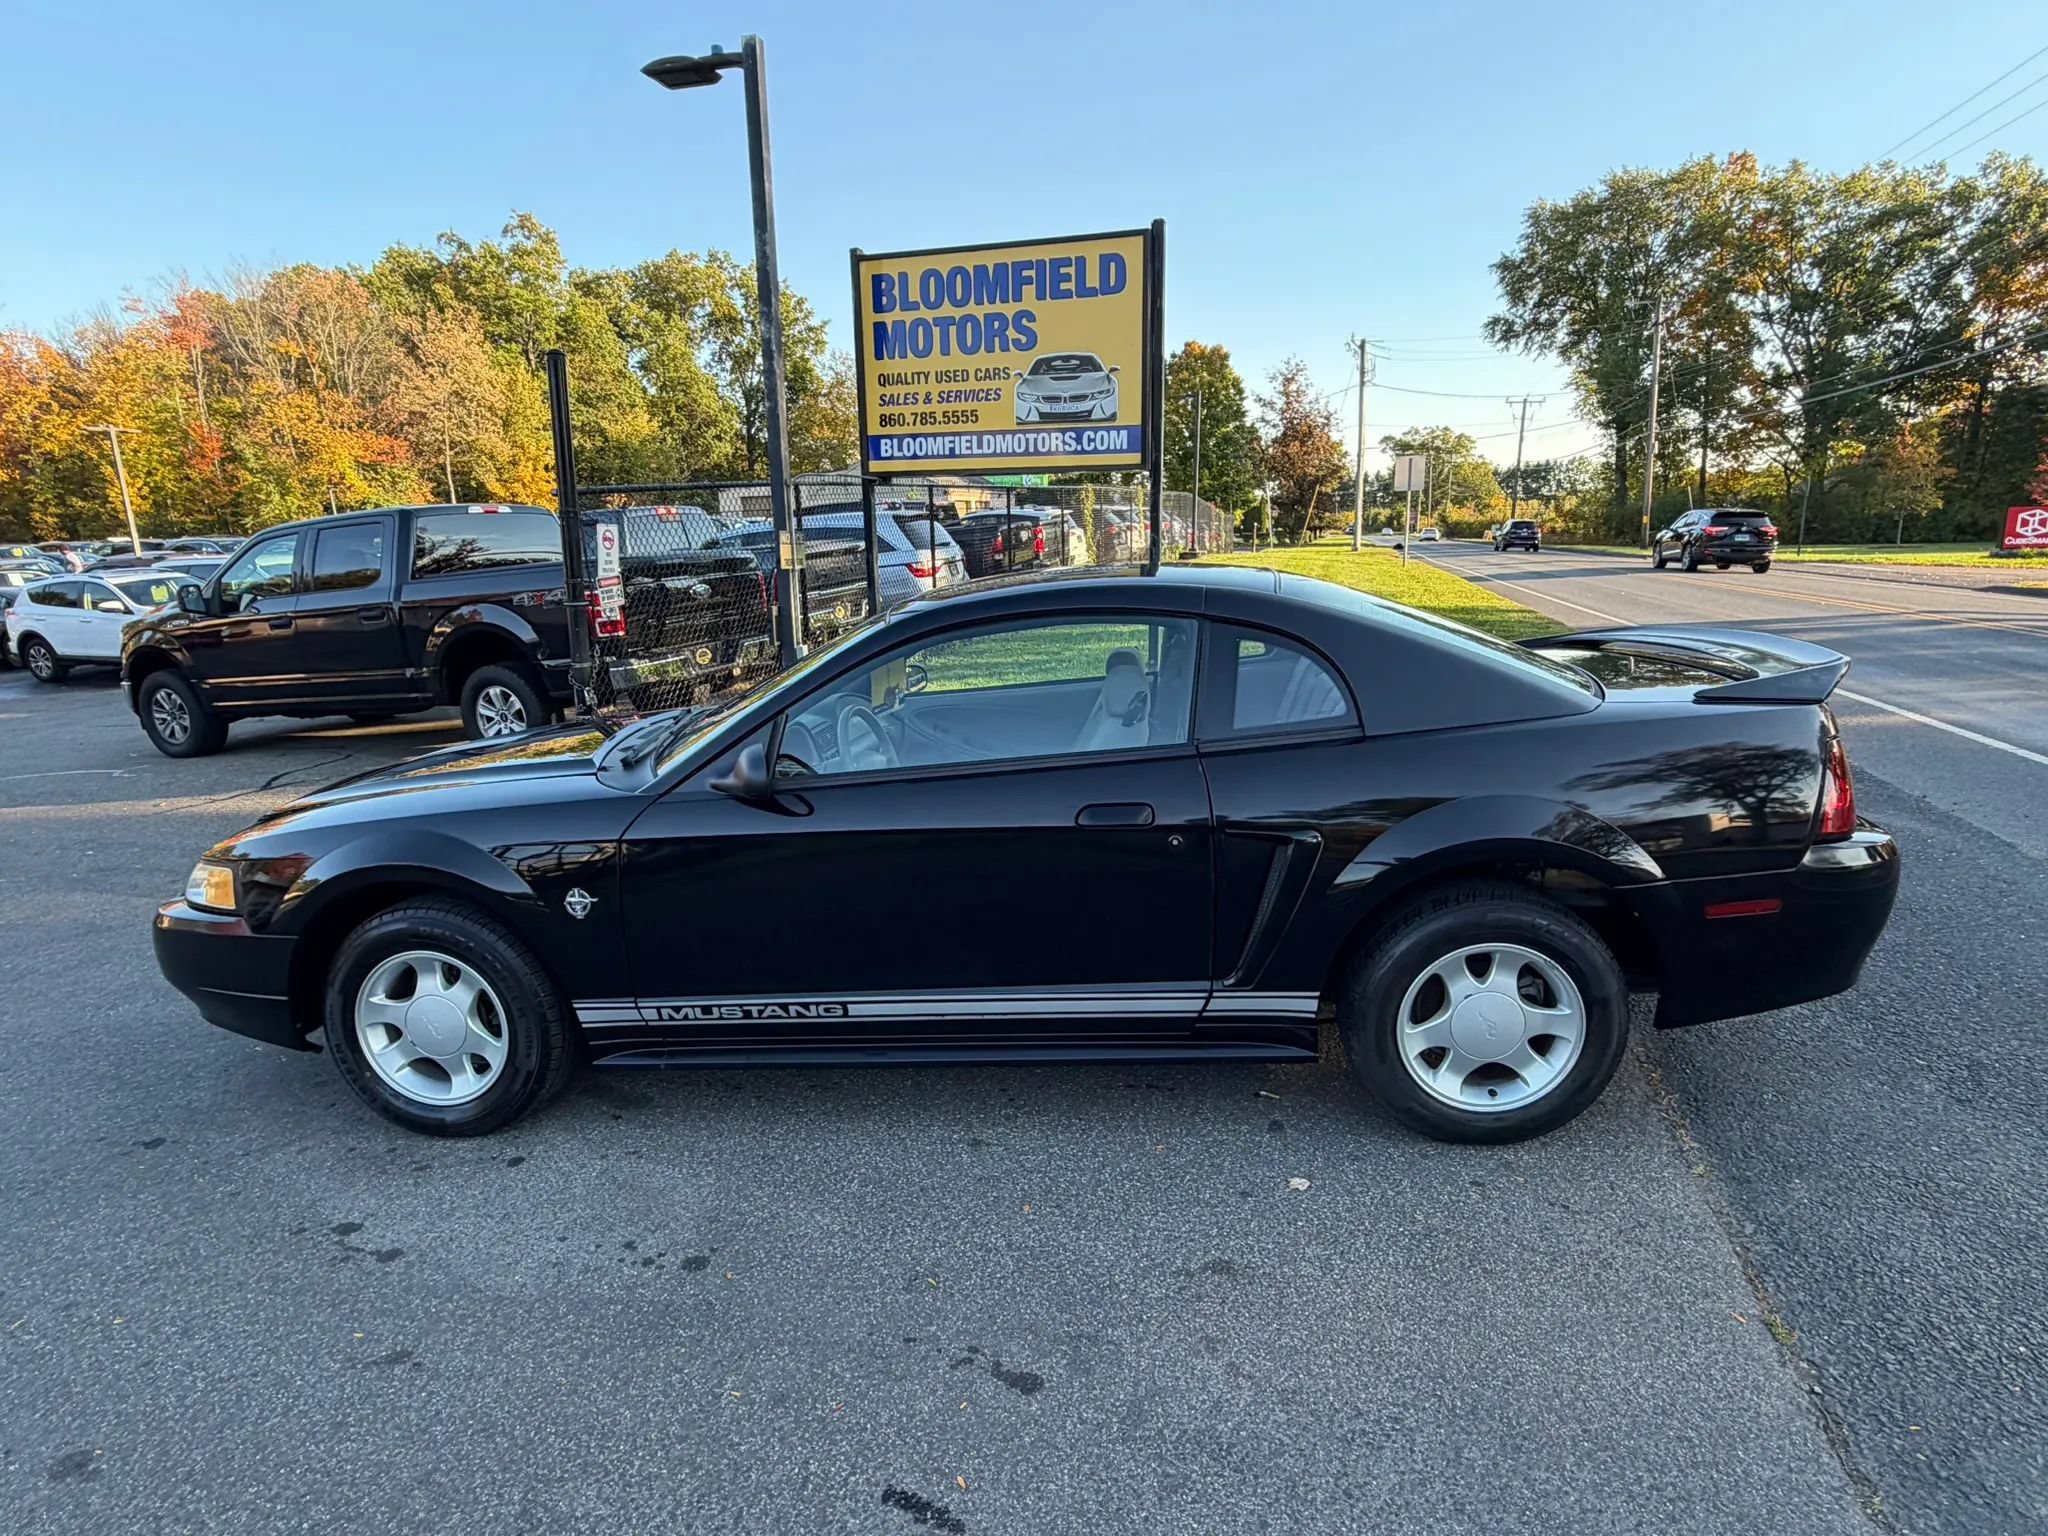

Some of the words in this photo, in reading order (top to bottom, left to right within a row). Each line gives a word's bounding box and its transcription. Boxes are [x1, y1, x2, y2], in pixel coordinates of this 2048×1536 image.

[871, 252, 1127, 314] BLOOMFIELD
[873, 309, 1038, 361] MOTORS
[877, 371, 931, 388] QUALITY
[934, 369, 970, 384] USED
[974, 366, 1011, 382] CARS
[878, 391, 920, 408] SALES
[922, 390, 934, 405] &
[936, 387, 1002, 405] SERVICES
[879, 409, 979, 428] 860.785.5555
[880, 429, 1128, 457] BLOOMFIELDMOTORS.COM
[660, 1004, 844, 1020] MUSTANG
